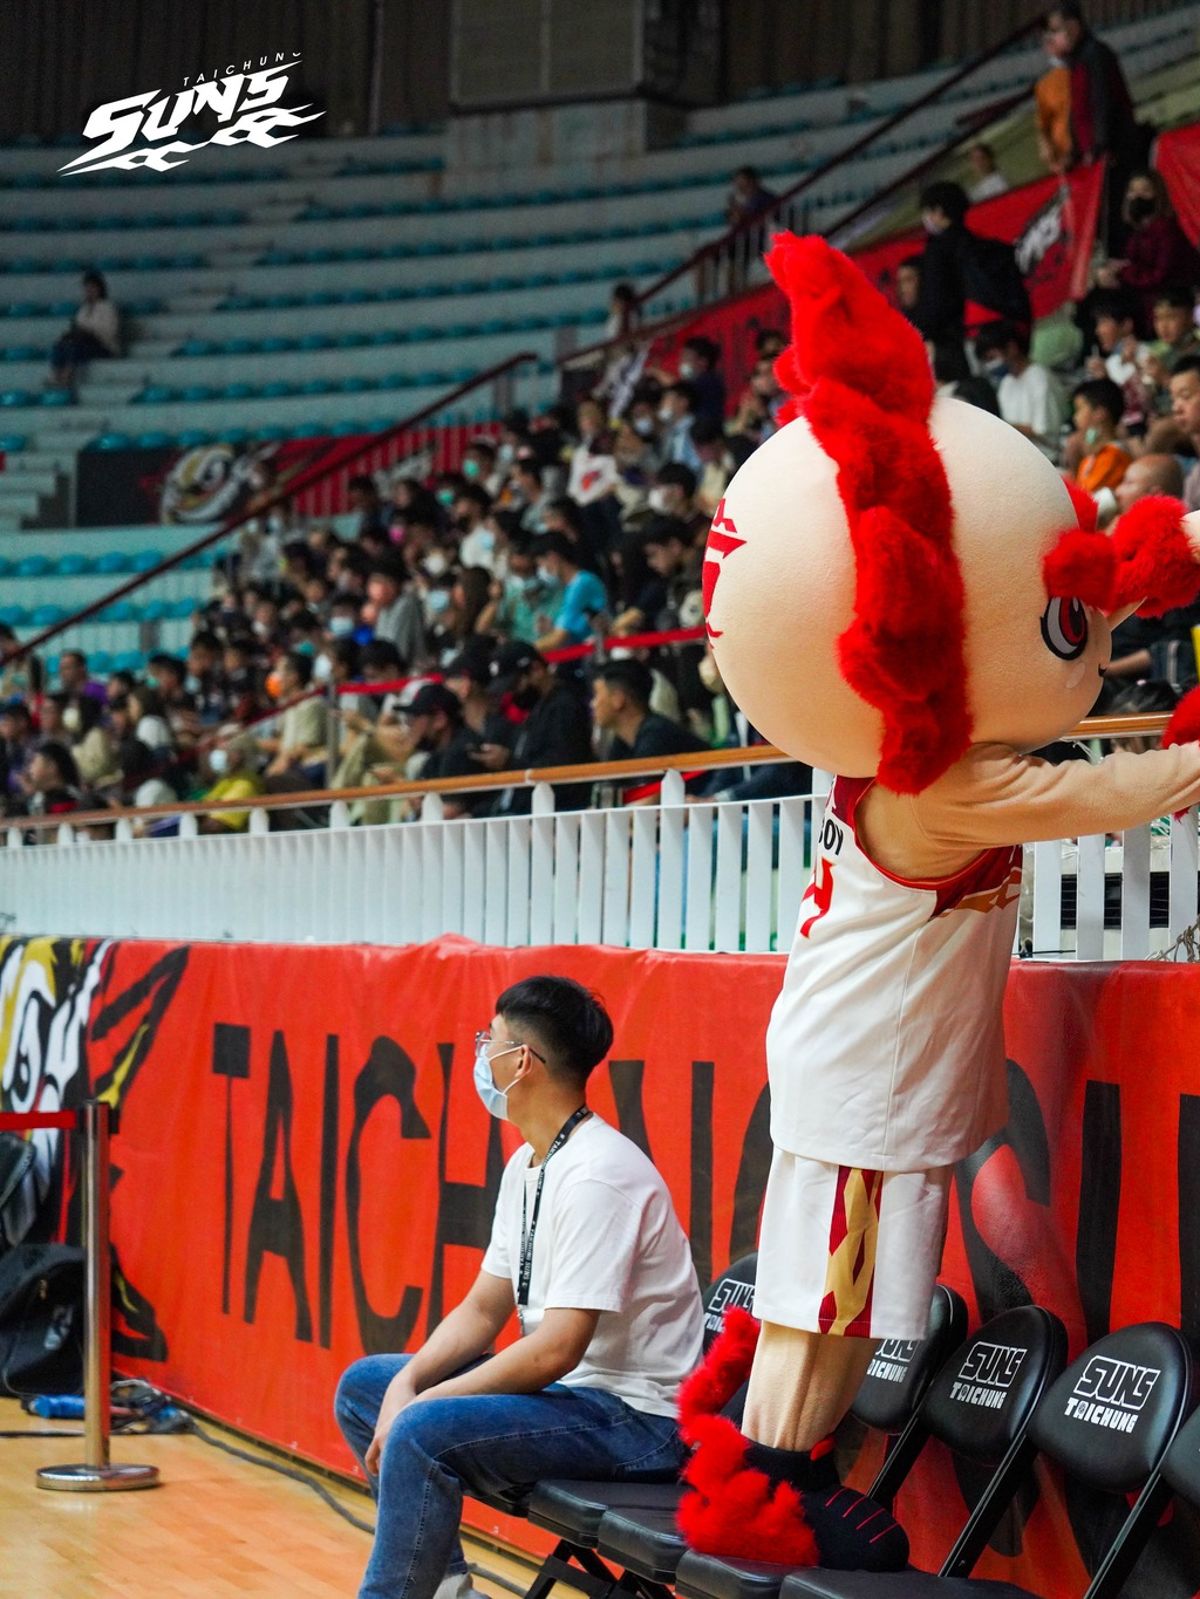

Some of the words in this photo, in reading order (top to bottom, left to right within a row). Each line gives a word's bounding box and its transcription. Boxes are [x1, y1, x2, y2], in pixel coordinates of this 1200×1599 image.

[819, 818, 844, 856] OY
[213, 1022, 772, 1357] TAICHN
[866, 1359, 909, 1384] AICHUNG
[958, 1341, 1027, 1388] SUNS
[1073, 1355, 1161, 1411] SUNS
[950, 1381, 1008, 1410] TAICHUNG
[1064, 1397, 1139, 1434] TAICHUNG
